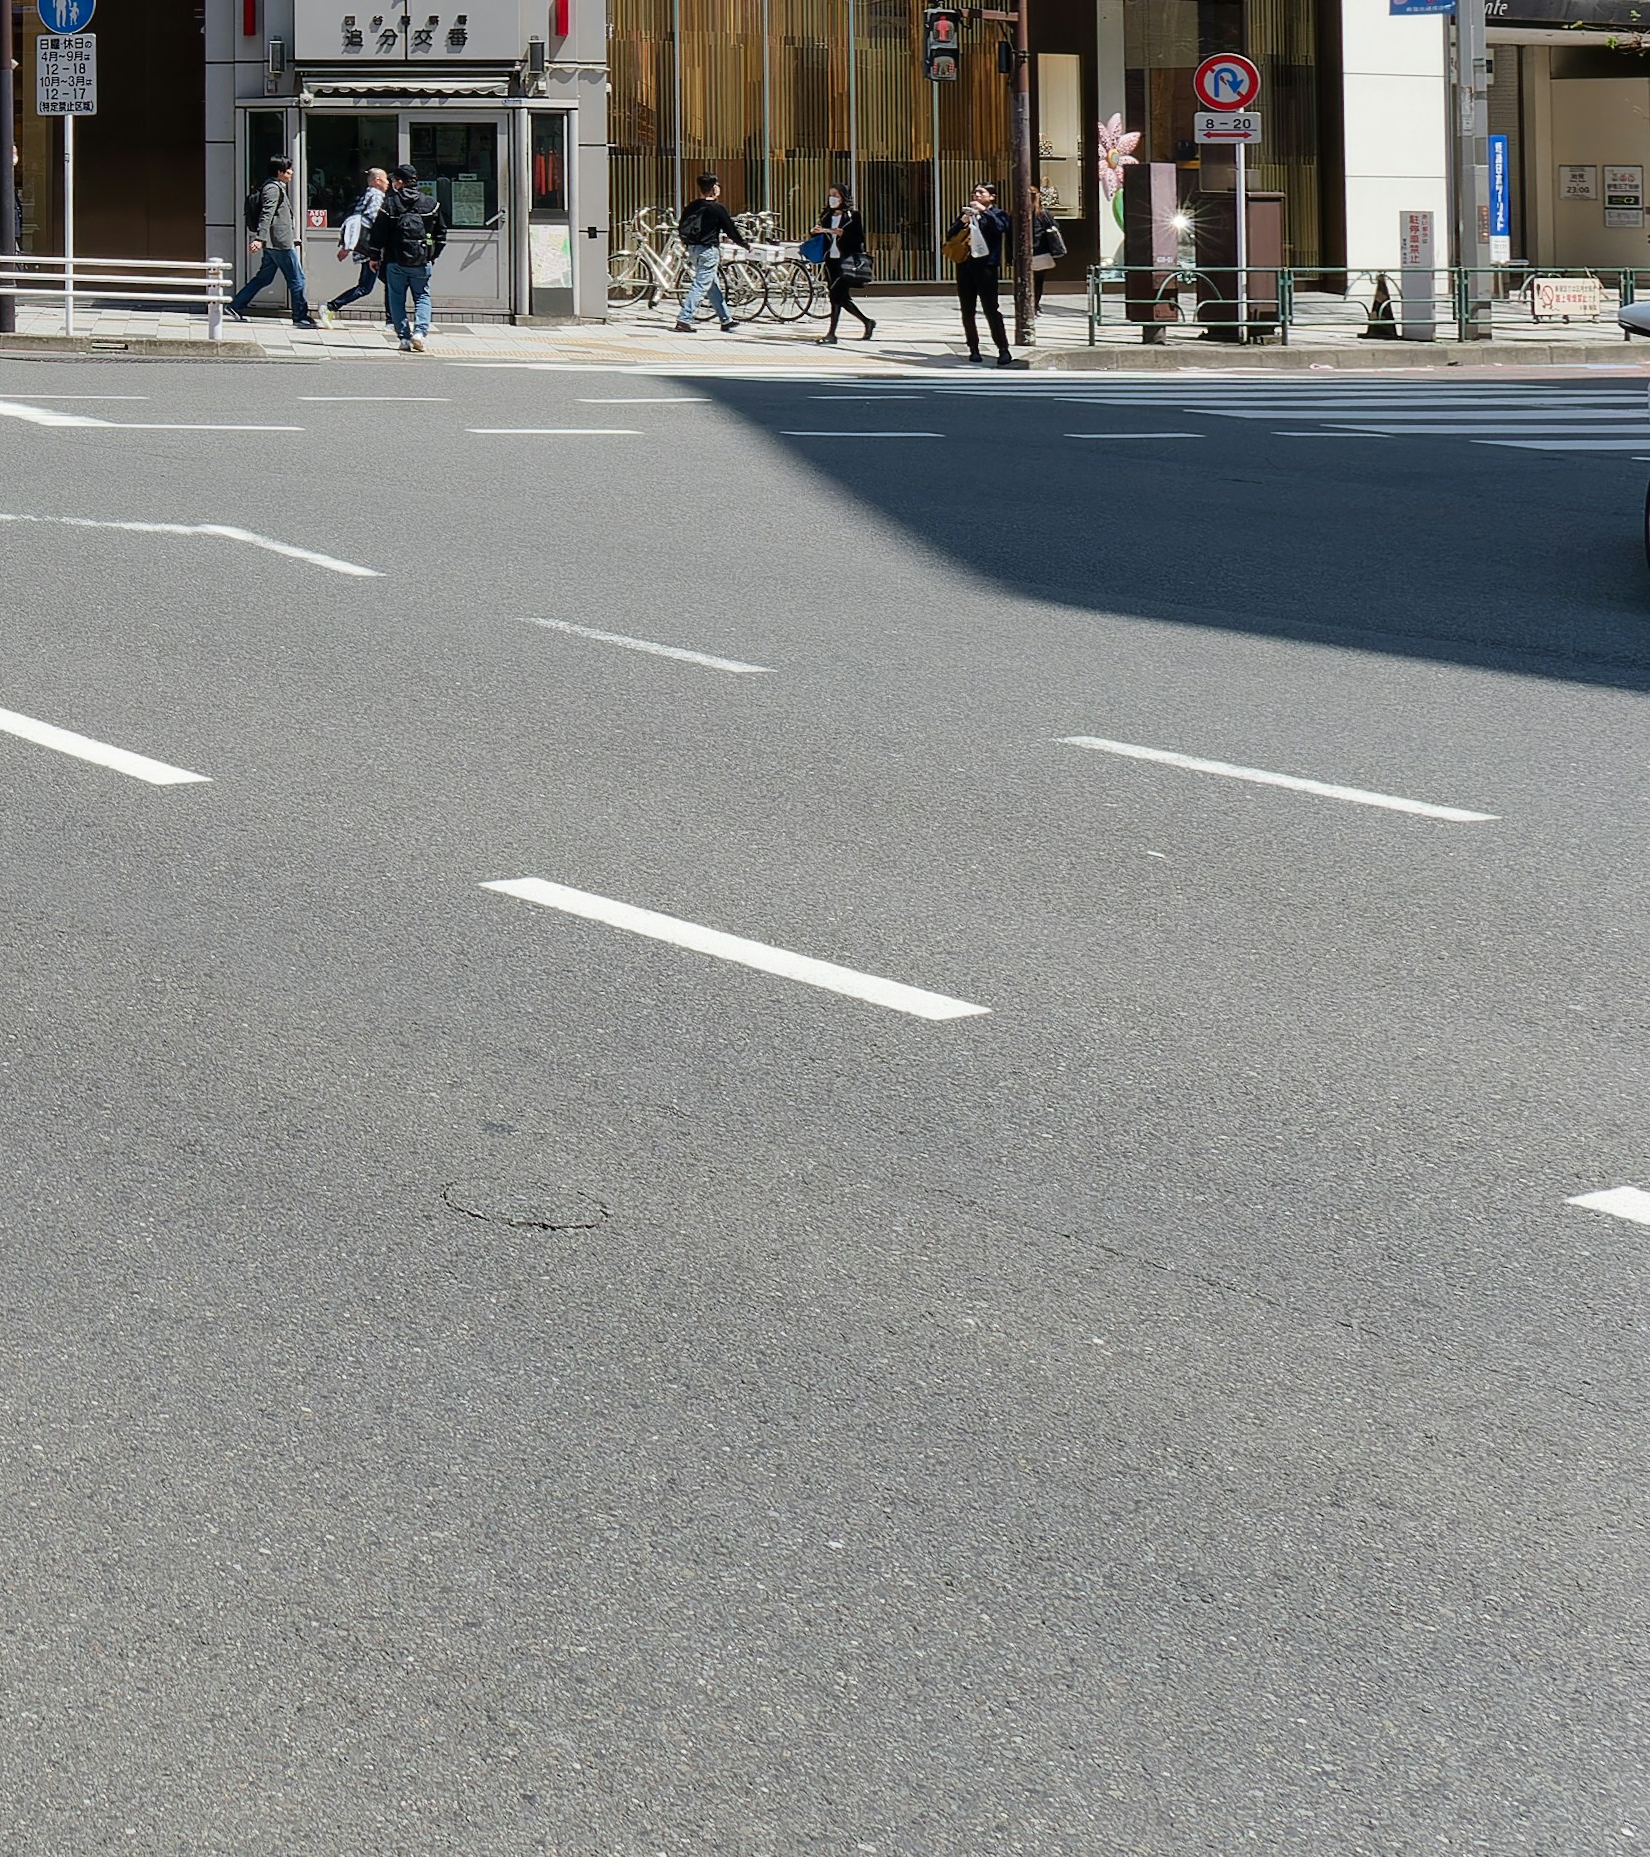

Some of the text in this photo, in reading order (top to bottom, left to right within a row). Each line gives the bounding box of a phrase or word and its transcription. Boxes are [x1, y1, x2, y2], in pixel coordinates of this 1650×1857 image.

[344, 28, 469, 47] 追分交番
[1409, 214, 1421, 265] 駐停車禁止
